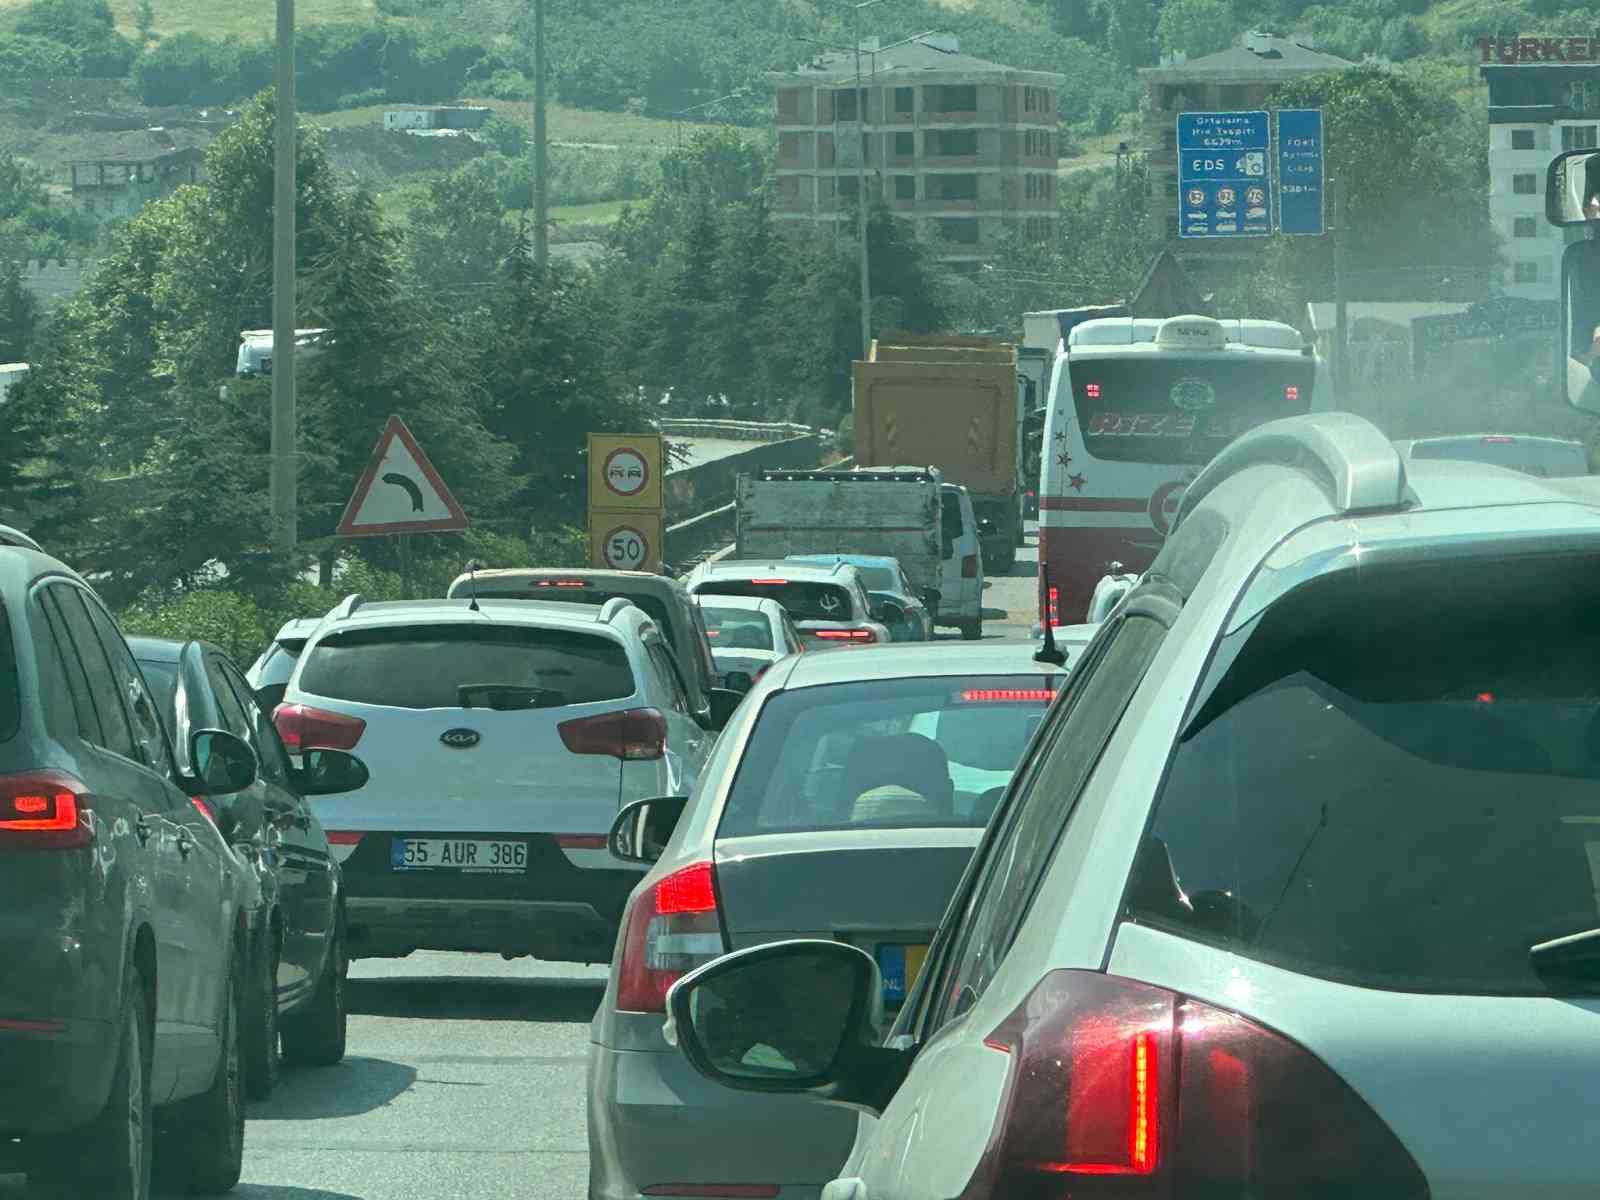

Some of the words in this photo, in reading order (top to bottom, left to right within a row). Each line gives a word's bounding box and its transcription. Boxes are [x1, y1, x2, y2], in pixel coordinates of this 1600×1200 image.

[1192, 158, 1225, 171] EDS
[612, 538, 640, 561] 50
[404, 841, 429, 863] 55
[440, 842, 478, 864] AUR
[489, 843, 526, 866] 386
[883, 978, 901, 991] NL
